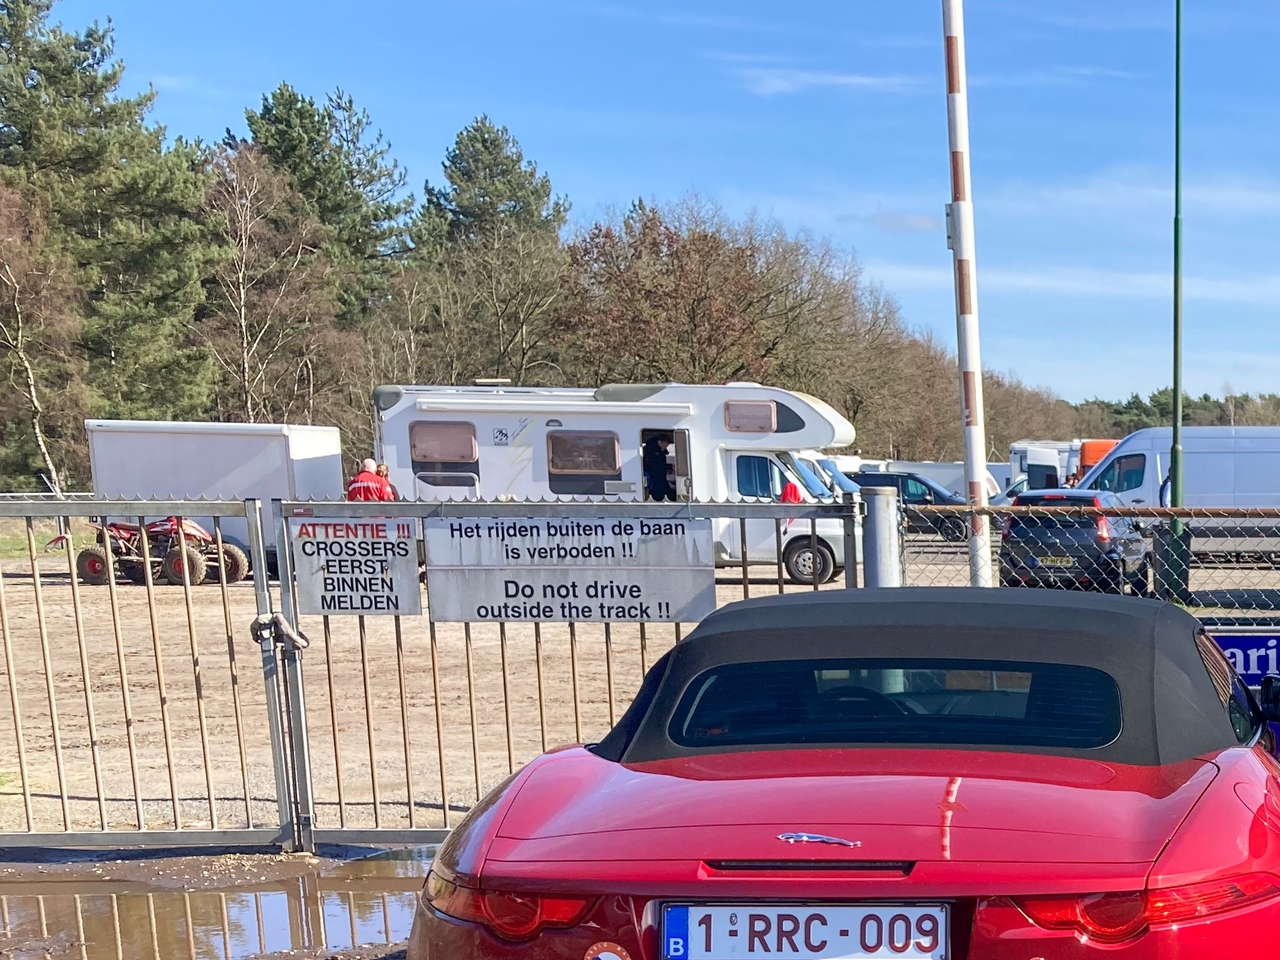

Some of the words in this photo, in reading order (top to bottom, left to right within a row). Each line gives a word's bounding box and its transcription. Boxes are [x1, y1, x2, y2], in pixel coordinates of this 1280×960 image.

[298, 523, 387, 539] ATTENTIE
[396, 523, 411, 539] !!!
[450, 522, 482, 538] Het
[487, 522, 540, 542] rijden
[546, 521, 605, 537] buiten
[611, 520, 634, 536] de
[640, 520, 685, 536] baan
[301, 541, 409, 557] CROSSERS
[504, 544, 521, 559] is
[526, 543, 615, 559] verboden
[622, 542, 634, 558] !!
[325, 559, 388, 575] EERST
[323, 577, 394, 593] BINNEN
[504, 580, 534, 598] Do
[542, 581, 578, 598] not
[585, 580, 642, 599] drive
[320, 595, 400, 610] MELDEN
[476, 601, 554, 619] outside
[560, 601, 593, 619] the
[598, 601, 651, 619] track
[658, 601, 671, 619] !!
[698, 913, 939, 953] 1-RRC-009
[669, 938, 684, 956] B
